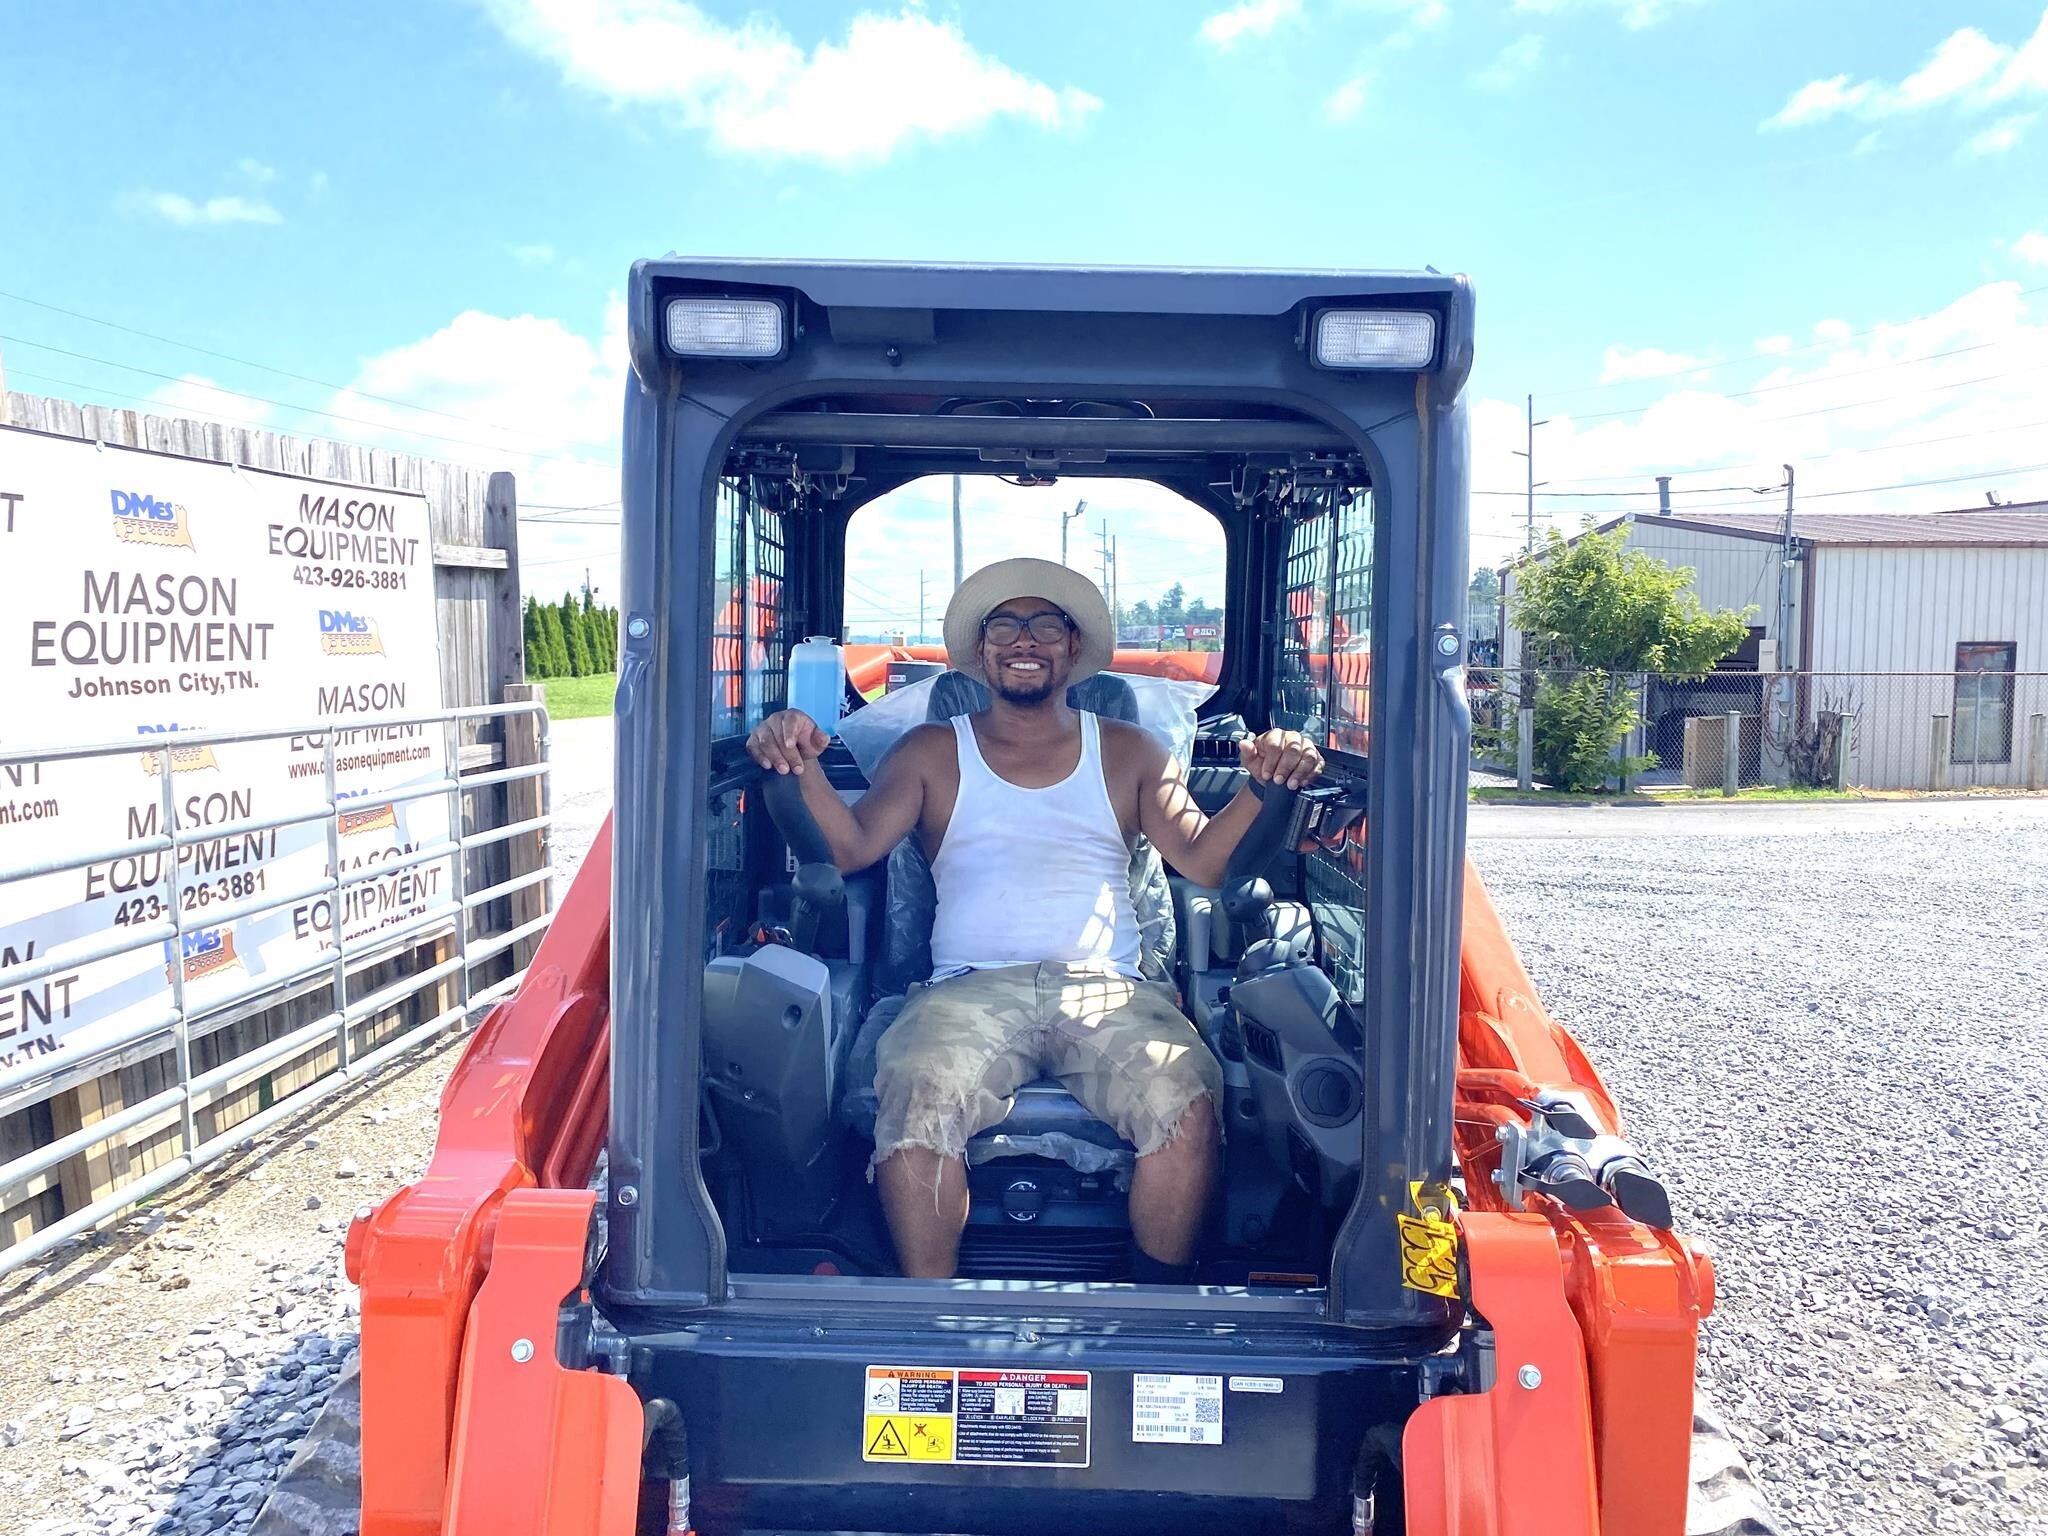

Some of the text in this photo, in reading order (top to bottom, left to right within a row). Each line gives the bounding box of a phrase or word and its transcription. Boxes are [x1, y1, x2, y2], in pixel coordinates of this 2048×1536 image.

[299, 493, 395, 532] MASON
[268, 524, 419, 566] EQUIPMENT
[84, 570, 236, 616] MASON
[293, 565, 407, 590] 423-926-3881
[31, 620, 274, 666] EQUIPMENT
[68, 670, 259, 699] Johnson City,TN.
[318, 682, 405, 715] MASON
[288, 745, 431, 779] www.asonequipment.com
[85, 829, 276, 902] EQUPMENT
[114, 869, 266, 926] 423-26-3881
[1009, 1373, 1047, 1382] DANGER
